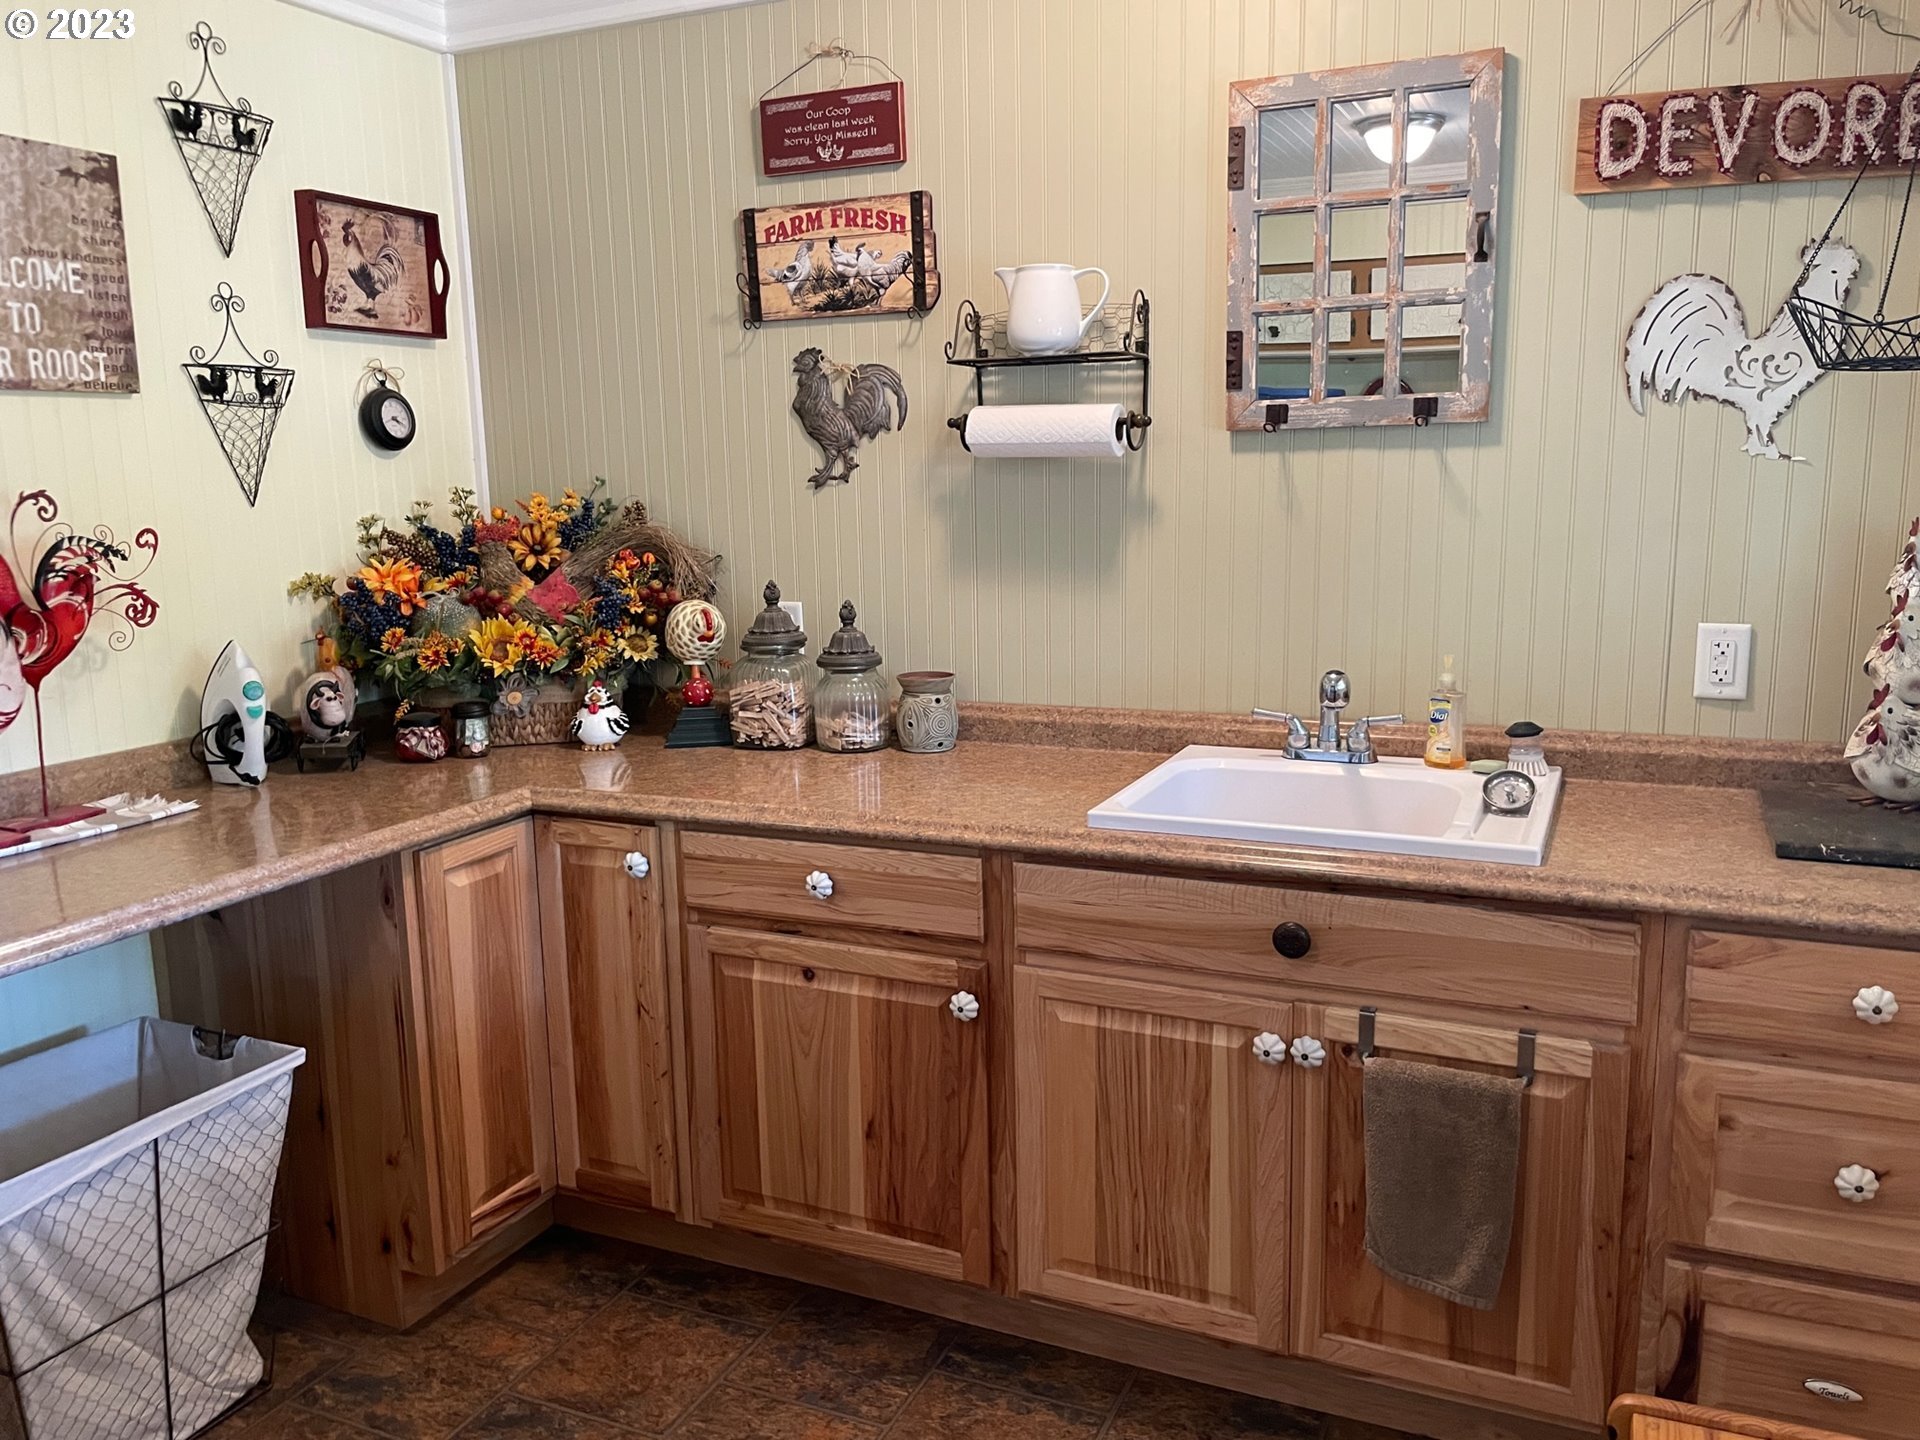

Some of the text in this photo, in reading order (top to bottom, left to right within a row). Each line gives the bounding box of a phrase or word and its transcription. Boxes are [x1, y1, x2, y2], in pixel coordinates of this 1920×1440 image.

[805, 106, 851, 120] Our Coop
[784, 115, 875, 134] was clean last week
[814, 133, 833, 145] You
[835, 127, 869, 140] Missed
[870, 126, 877, 136] It
[71, 214, 88, 226] be
[763, 207, 907, 243] FARM FRESH
[82, 235, 120, 249] share
[21, 245, 123, 266] show kindness
[92, 273, 125, 285] good
[88, 289, 127, 302] listen
[6, 300, 40, 334] TO
[28, 347, 107, 382] ROOST
[1430, 710, 1448, 720] Dial
[1819, 1386, 1850, 1401] Towels
